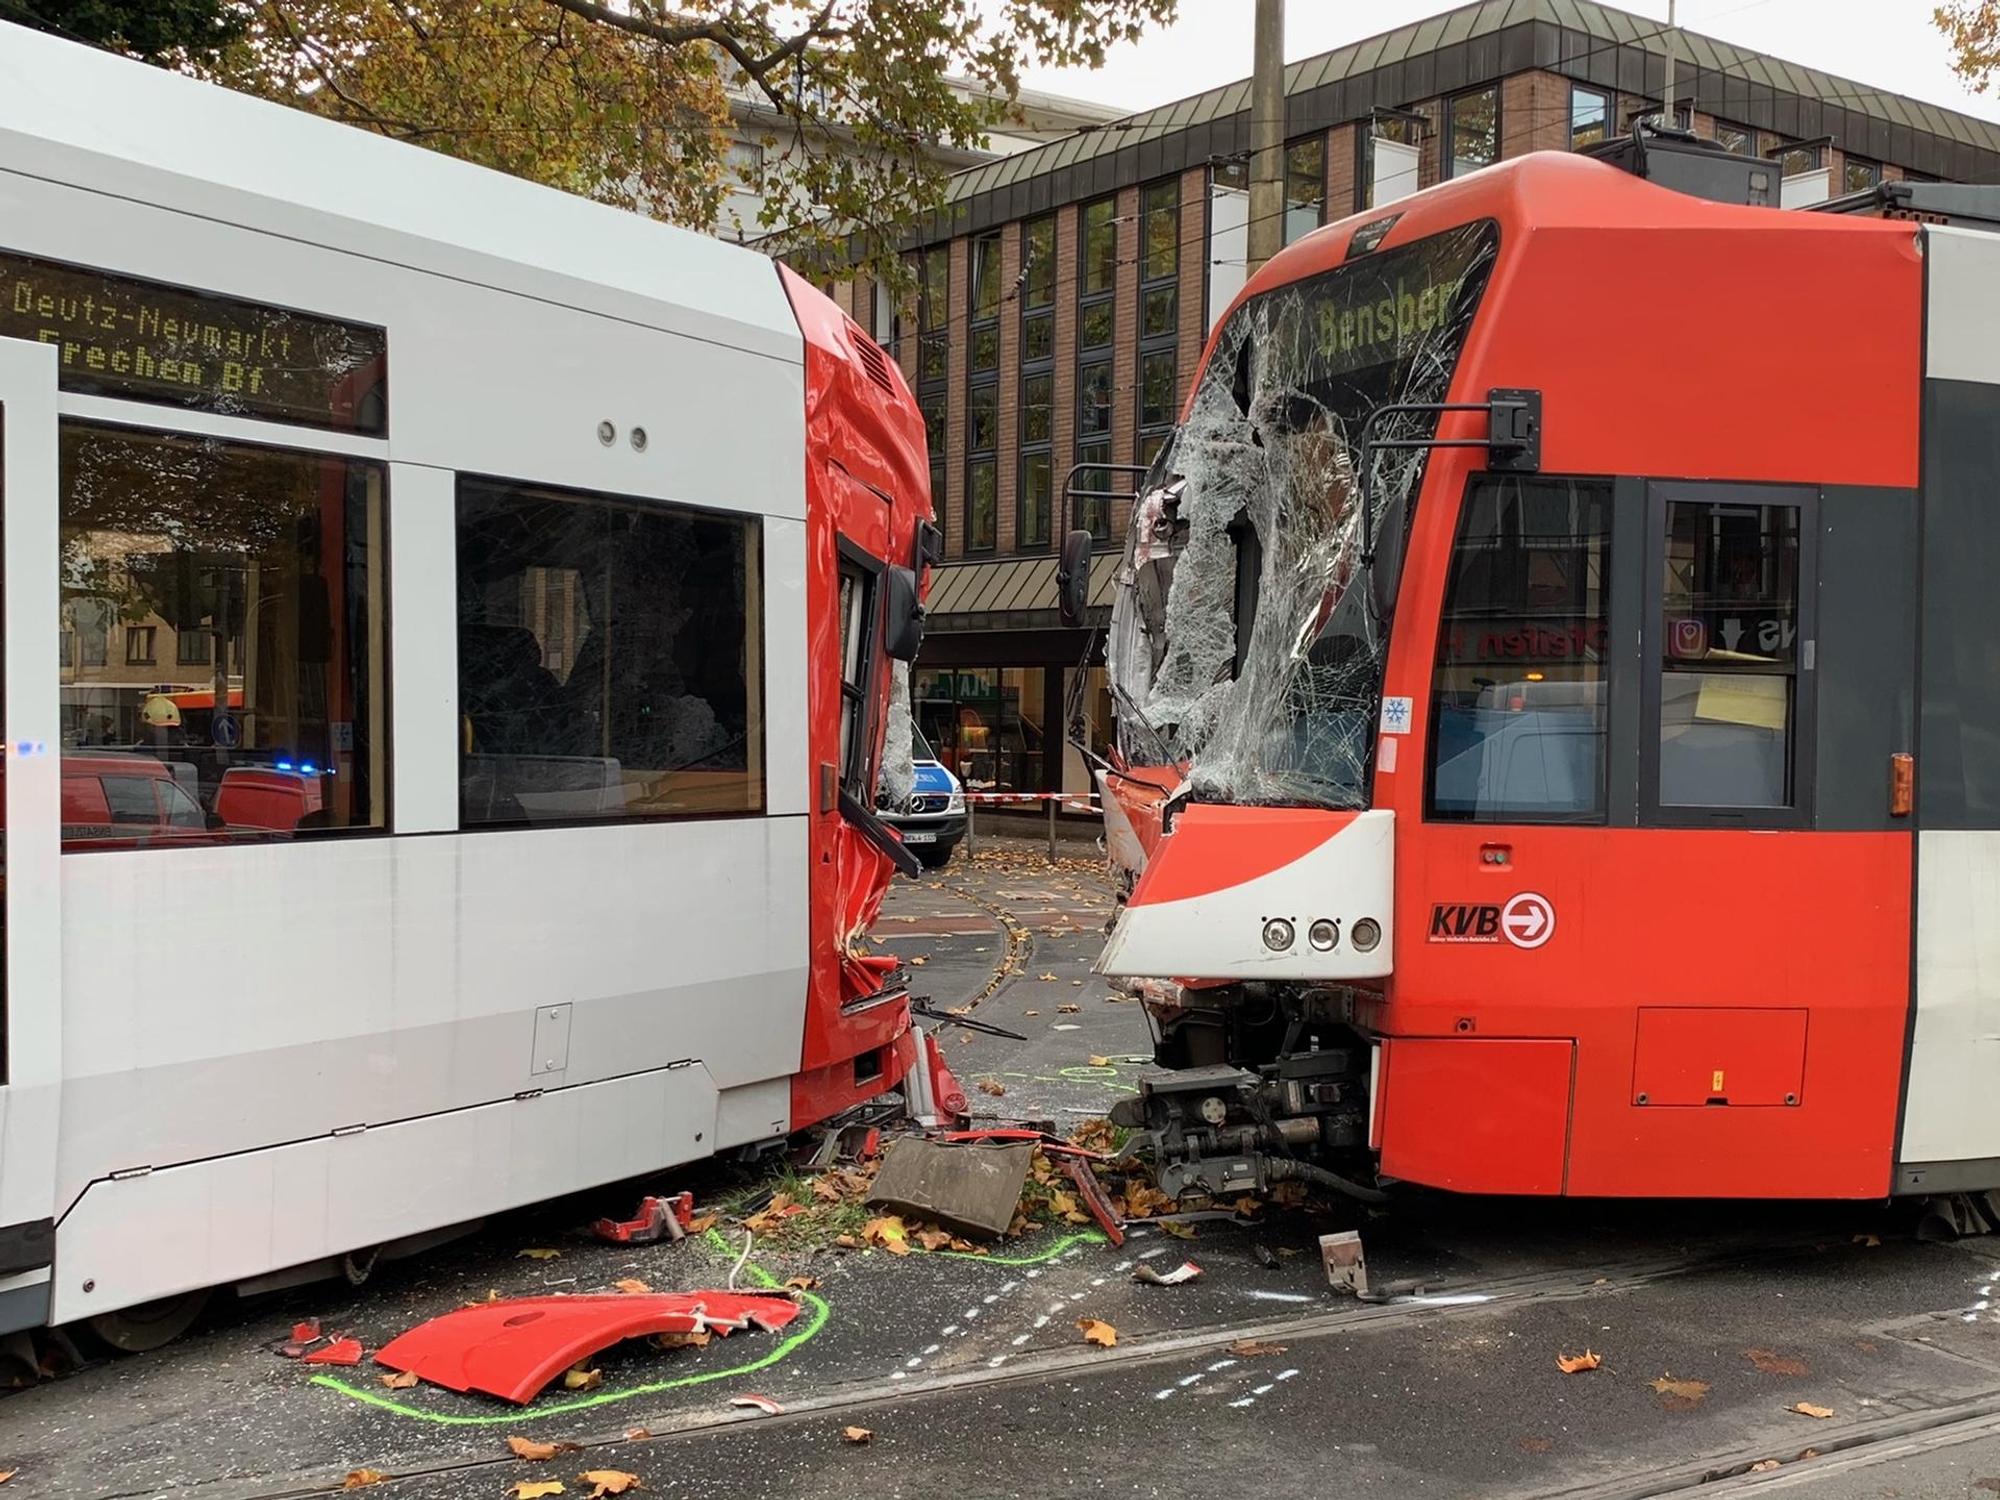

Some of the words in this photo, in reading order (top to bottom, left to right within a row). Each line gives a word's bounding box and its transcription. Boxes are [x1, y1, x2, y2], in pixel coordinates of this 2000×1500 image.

[14, 281, 291, 361] Deutz-Neumarkt
[222, 361, 265, 394] Bf
[1430, 906, 1500, 935] KVB
